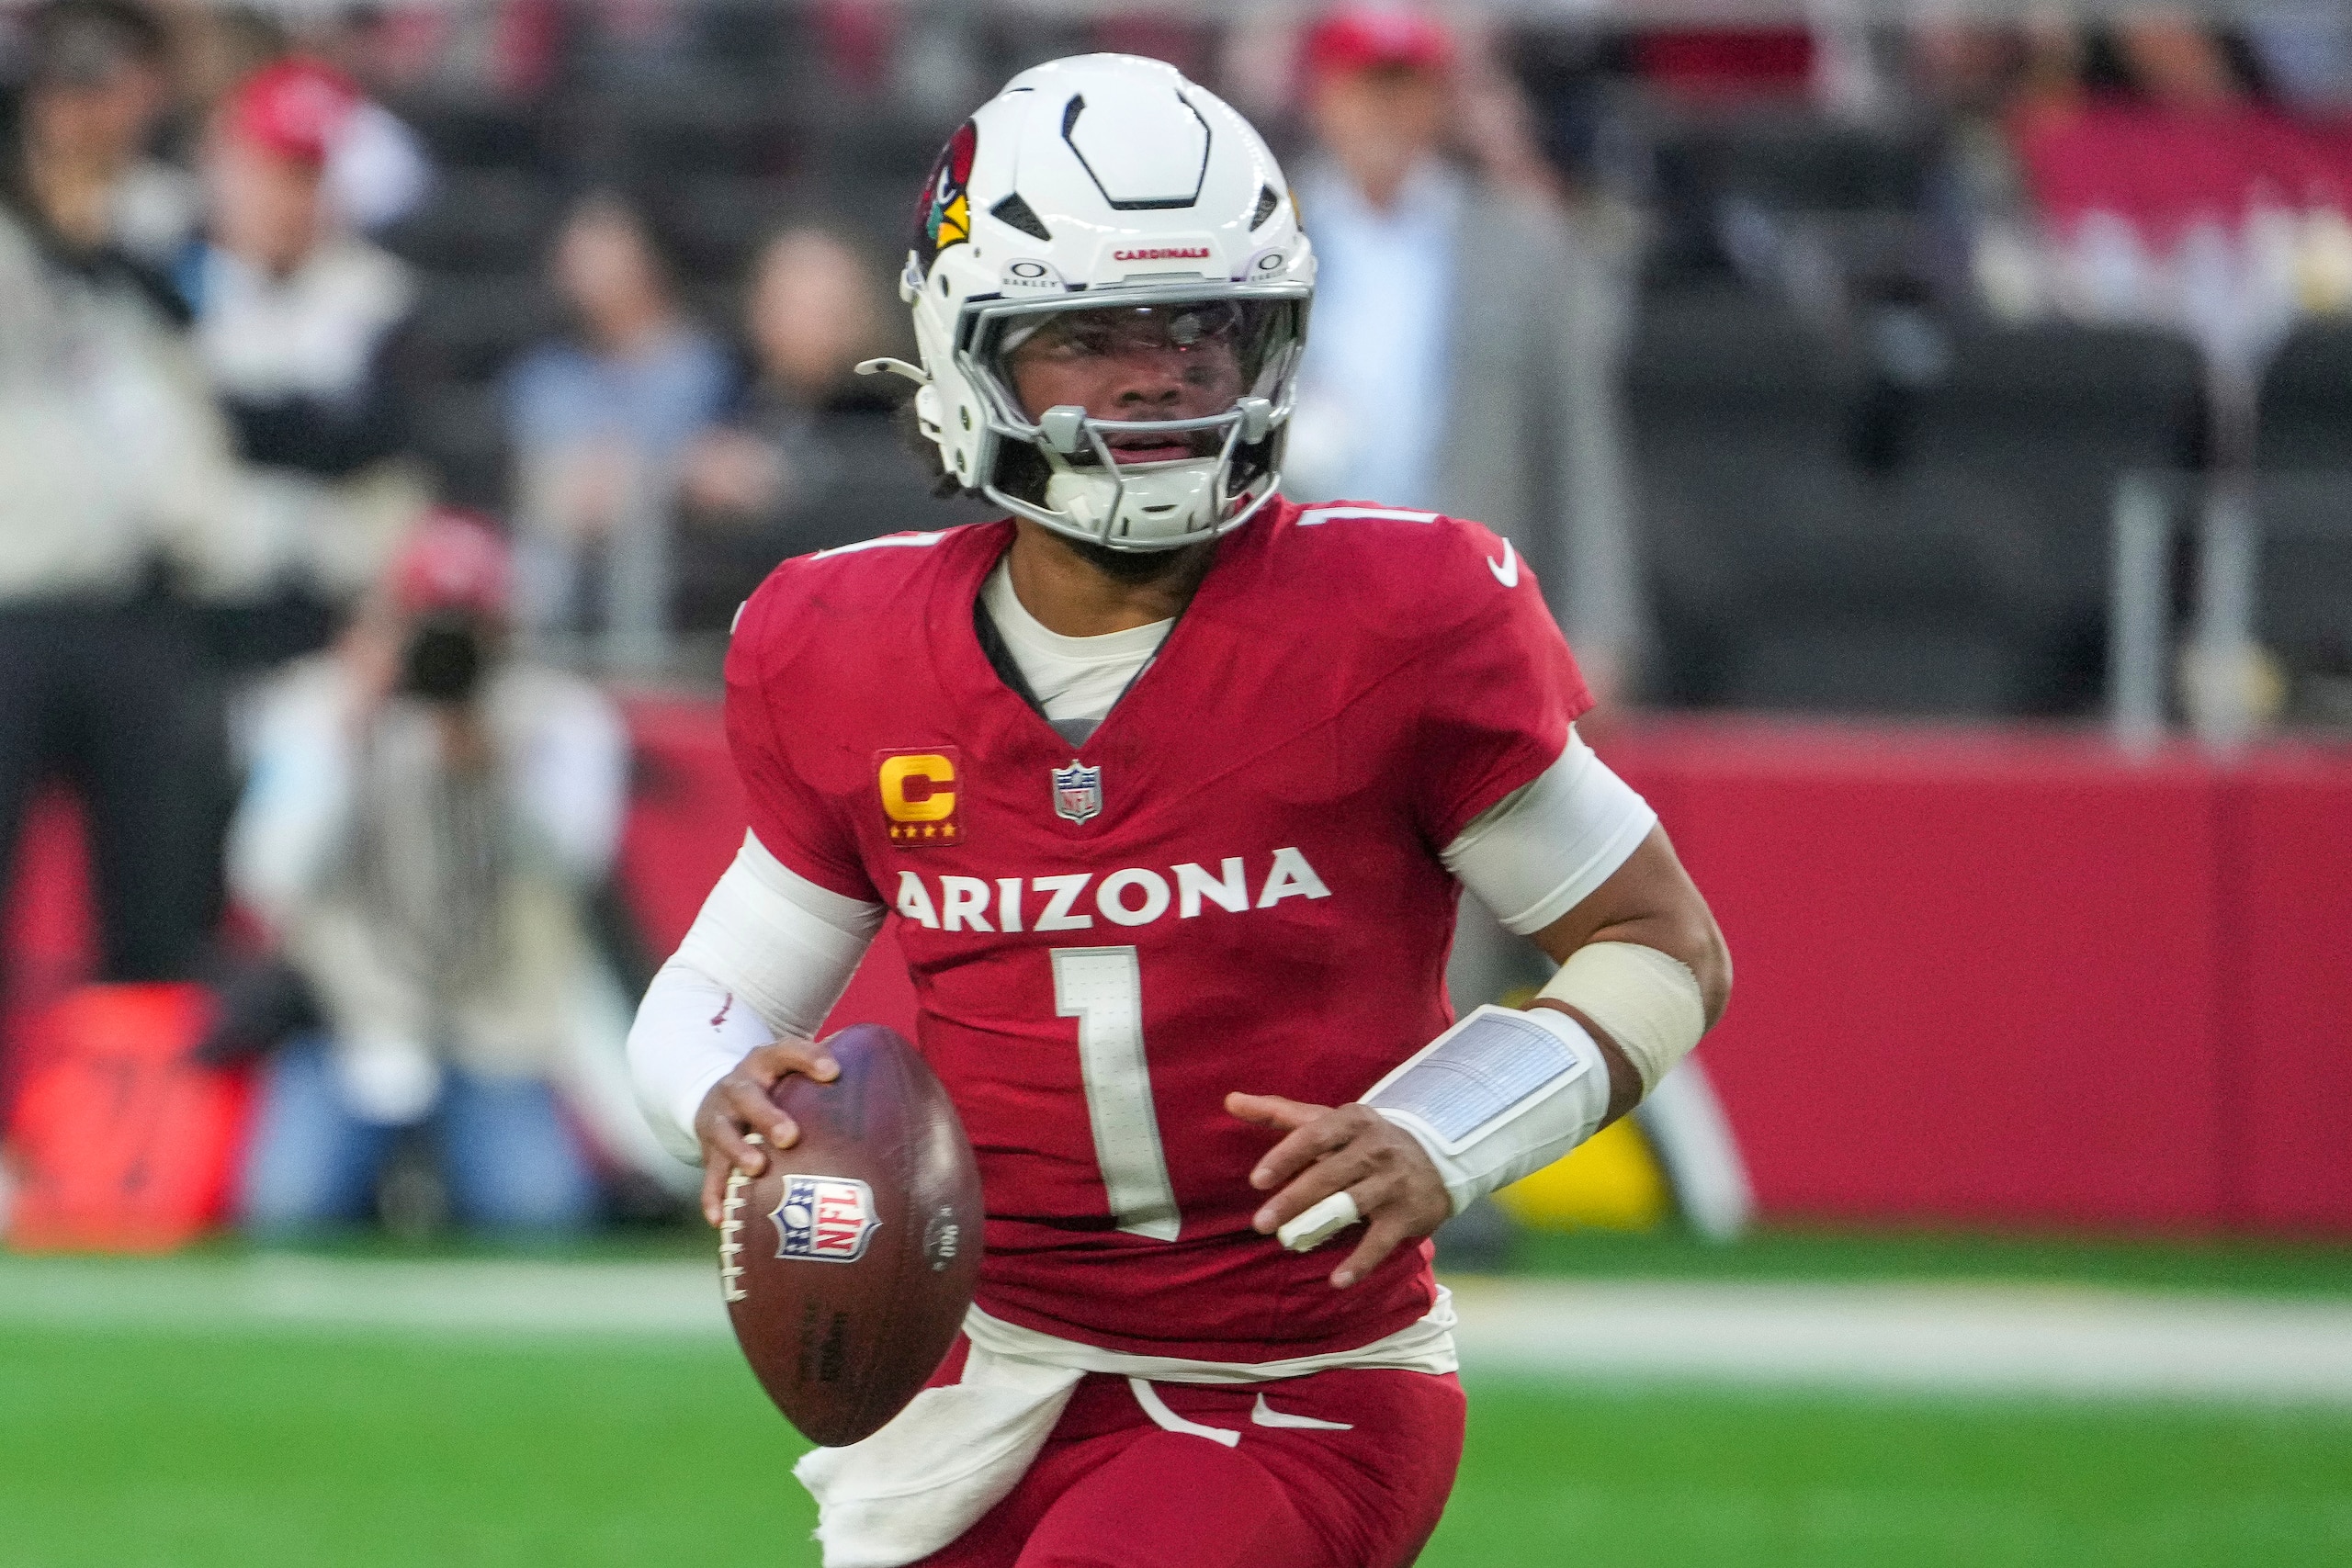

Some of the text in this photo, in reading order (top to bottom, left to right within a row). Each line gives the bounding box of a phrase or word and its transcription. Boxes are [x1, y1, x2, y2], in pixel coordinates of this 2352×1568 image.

[1113, 246, 1211, 262] CARDINALS
[878, 753, 956, 822] C
[1060, 790, 1093, 813] NFL
[896, 846, 1332, 933] ARIZONA
[1049, 944, 1182, 1243] 1
[816, 1190, 865, 1252] NFL
